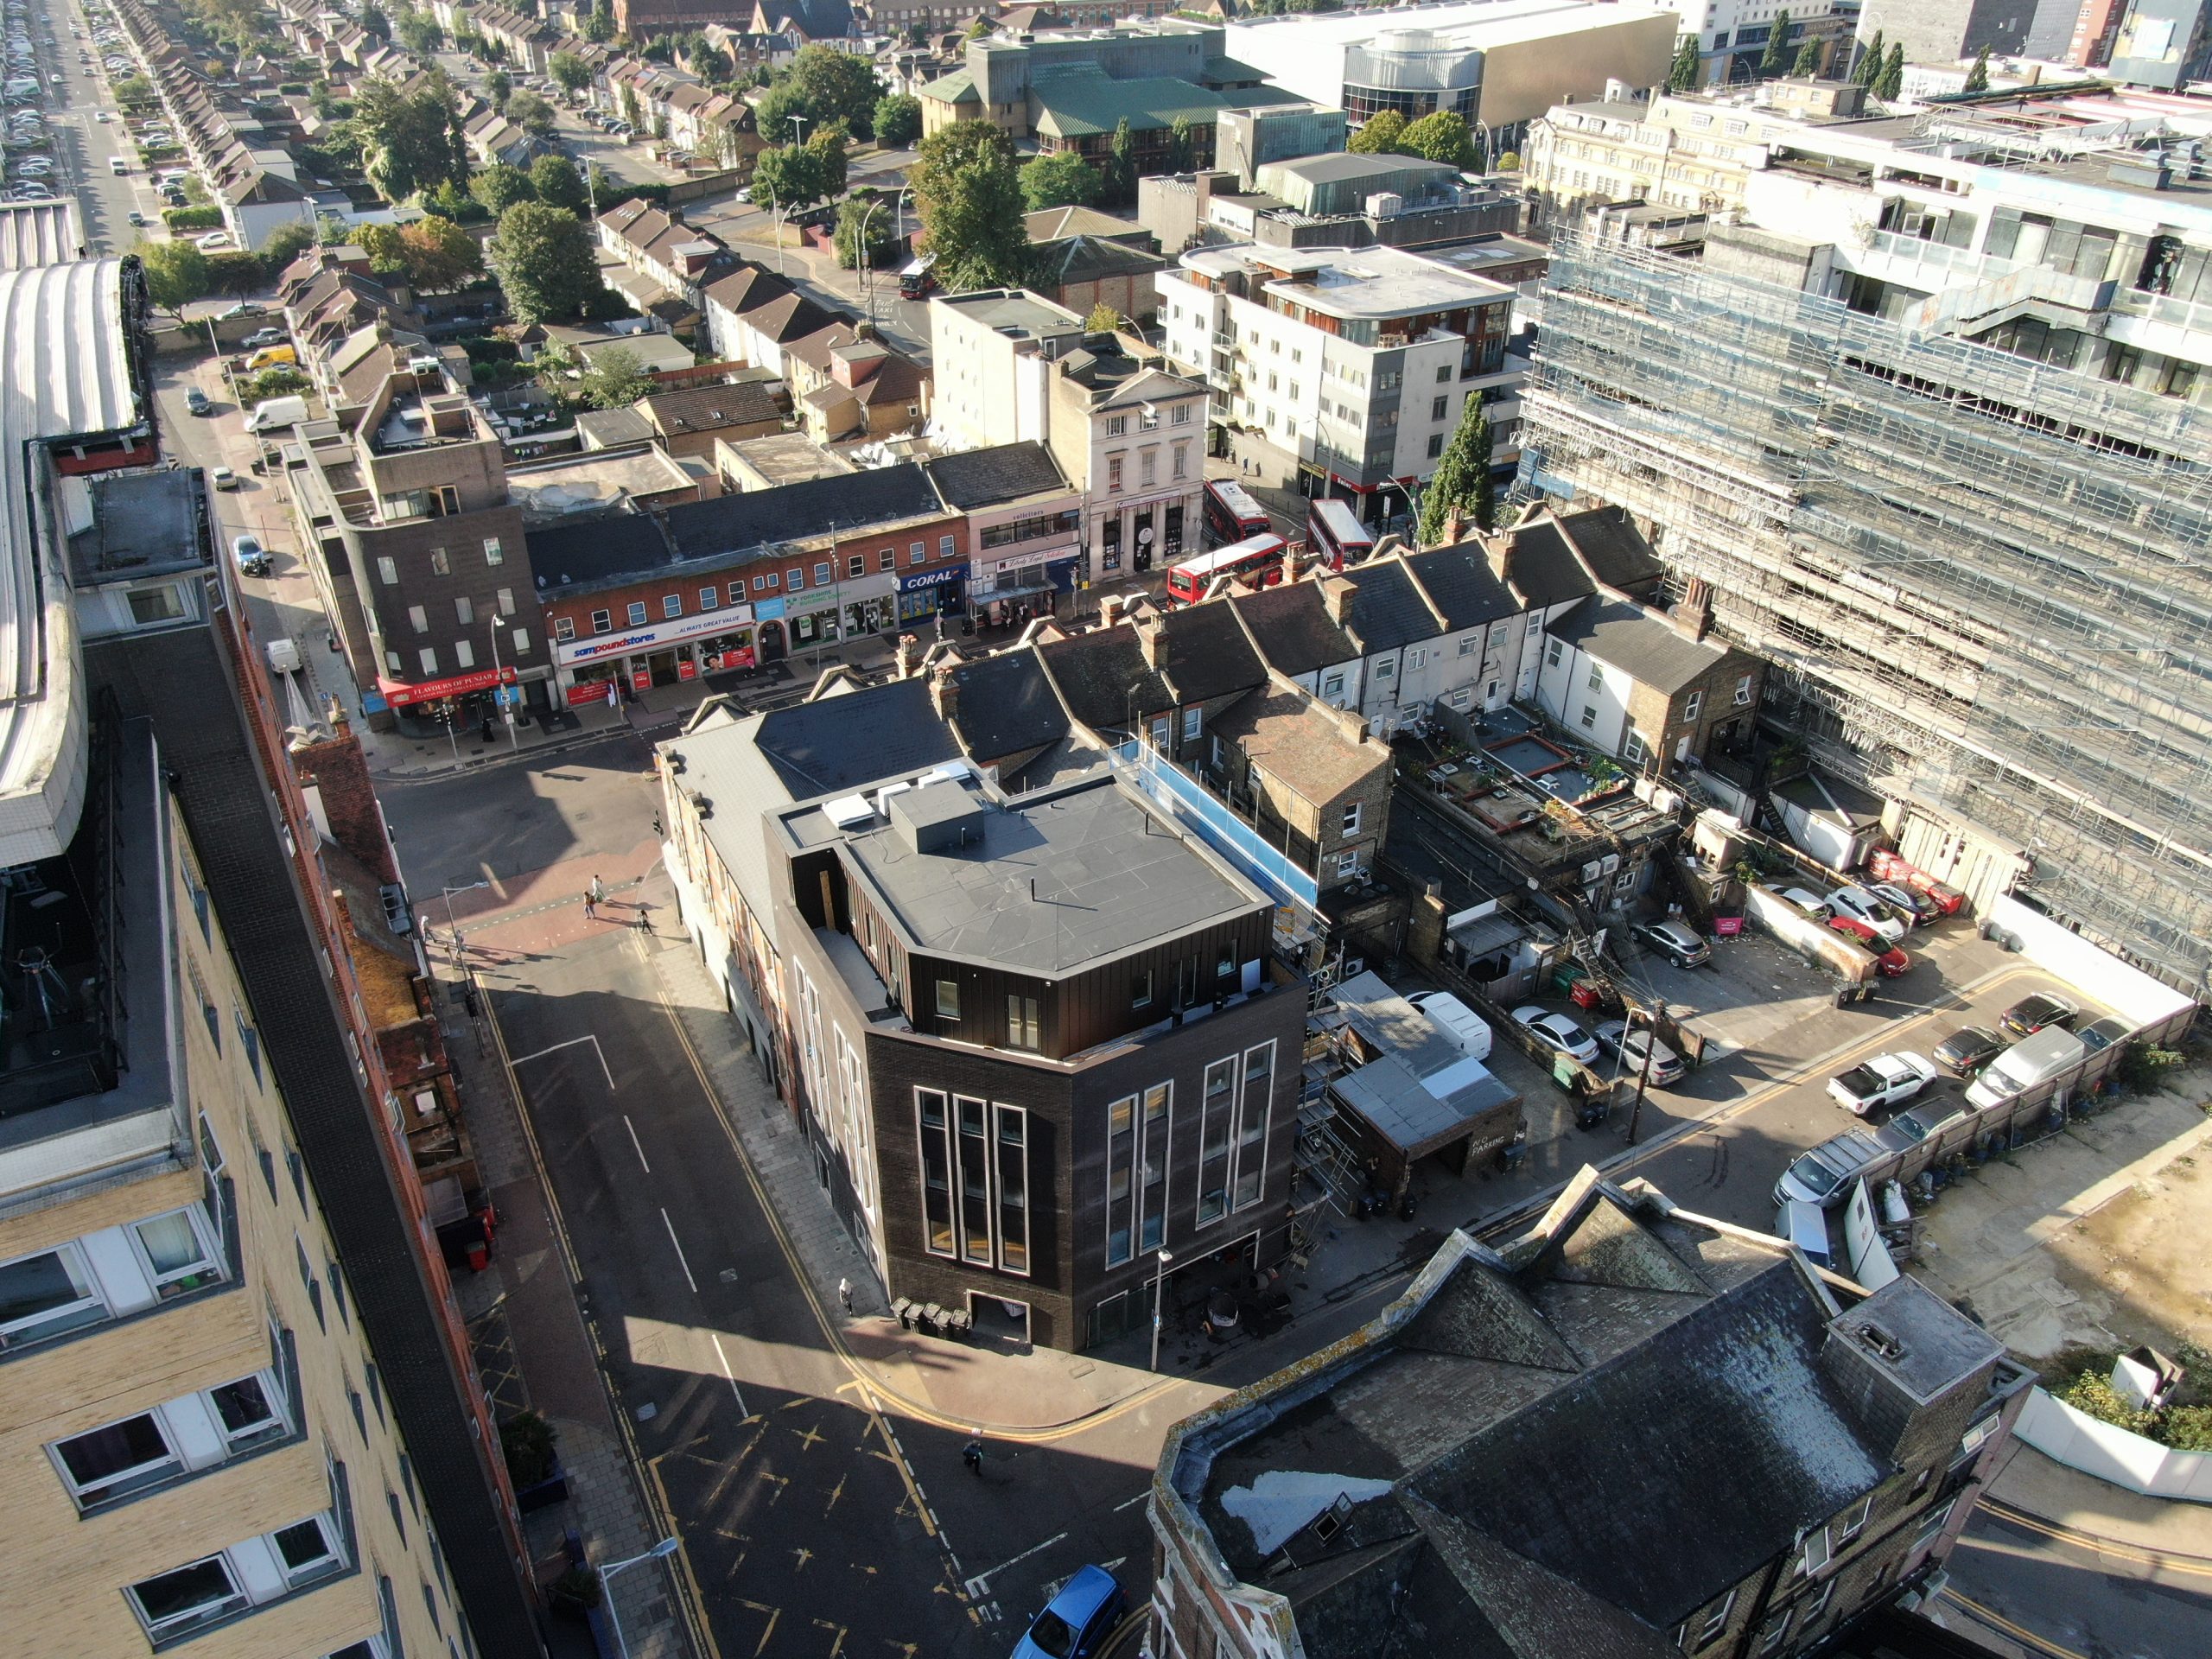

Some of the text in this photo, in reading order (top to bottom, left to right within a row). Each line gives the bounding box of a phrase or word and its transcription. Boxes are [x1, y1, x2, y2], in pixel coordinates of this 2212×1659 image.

[1013, 510, 1044, 520] solicitors
[907, 570, 952, 589] CORAL
[800, 590, 831, 601] YORKSHIRE
[702, 619, 721, 628] GREAT
[722, 614, 741, 624] VALUE
[574, 633, 655, 657] sampoundstores
[414, 683, 452, 695] FLAVOURS
[464, 673, 493, 684] PUNJAB
